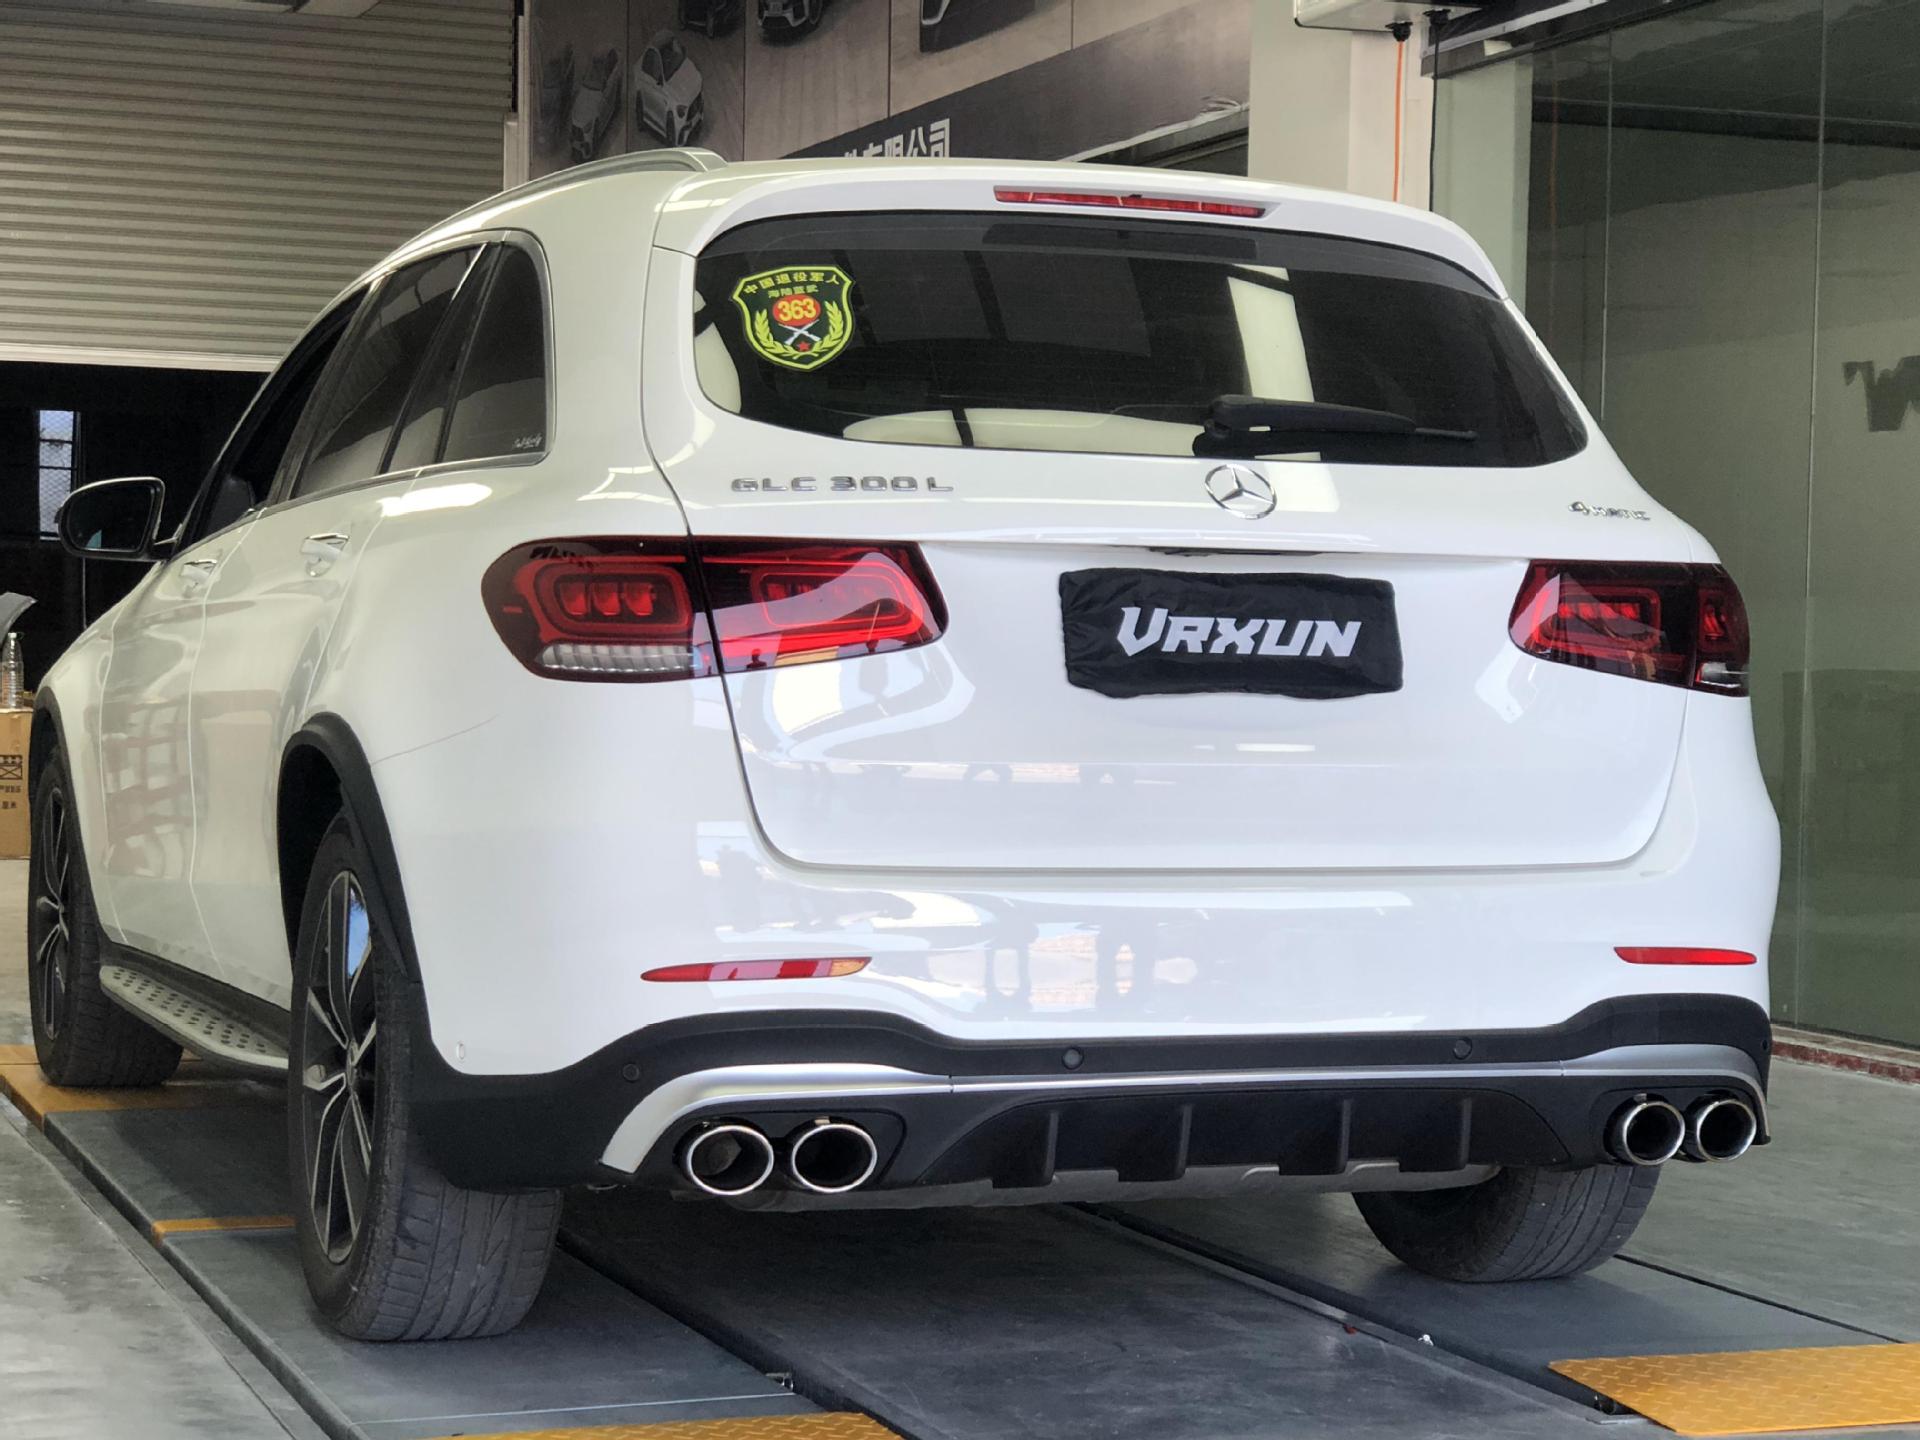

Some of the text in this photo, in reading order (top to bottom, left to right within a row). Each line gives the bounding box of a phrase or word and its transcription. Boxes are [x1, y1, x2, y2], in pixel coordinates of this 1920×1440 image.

[777, 298, 817, 321] 363
[731, 476, 954, 492] GLC 300 L
